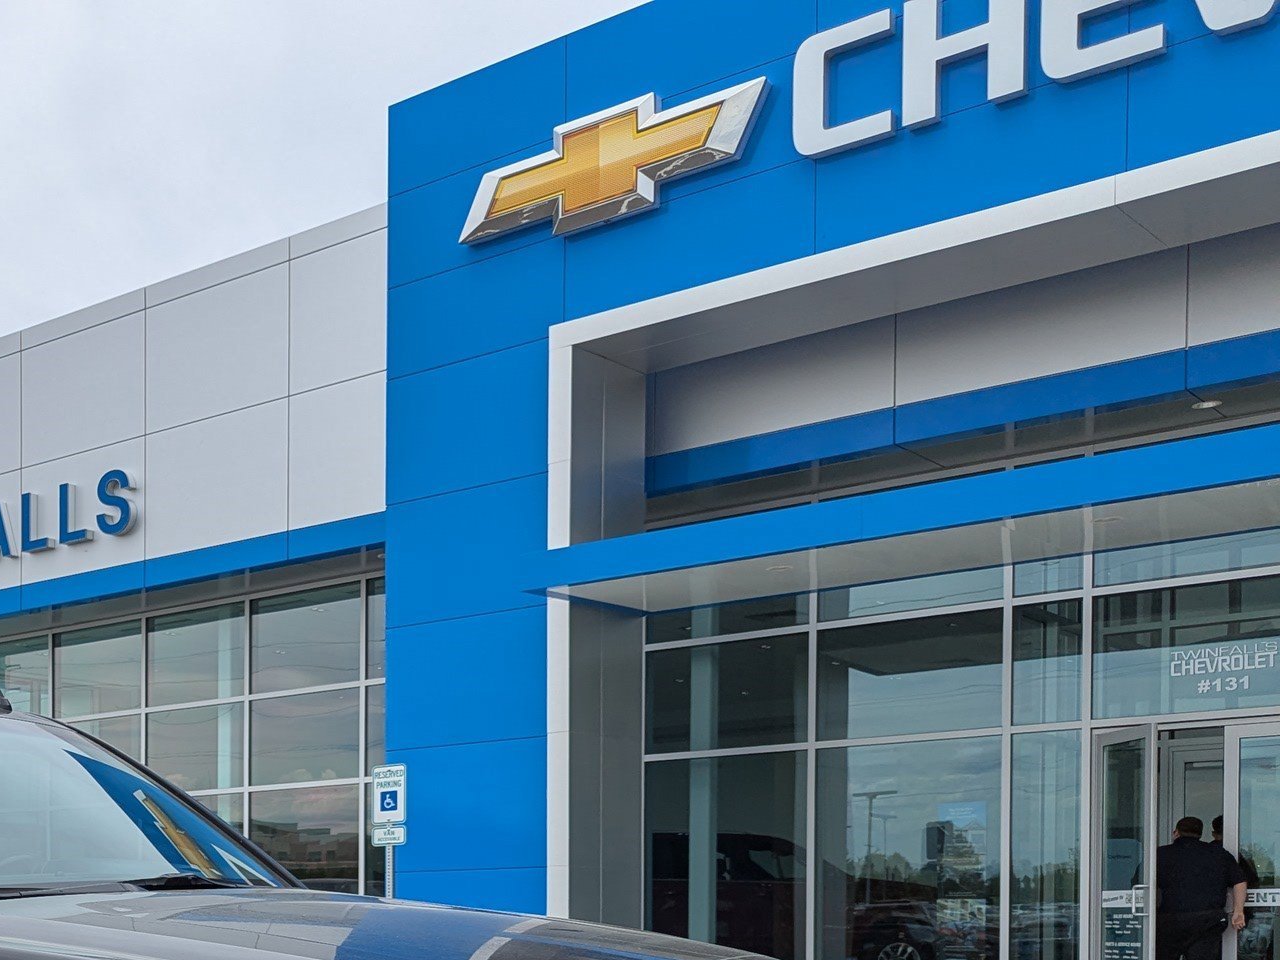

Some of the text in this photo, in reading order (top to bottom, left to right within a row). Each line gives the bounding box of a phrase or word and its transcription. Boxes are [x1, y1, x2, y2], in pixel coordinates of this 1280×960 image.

[1170, 651, 1278, 677] CHEVROLET
[1197, 675, 1250, 694] #131
[374, 769, 404, 779] RESERVED
[376, 780, 402, 789] PARKING
